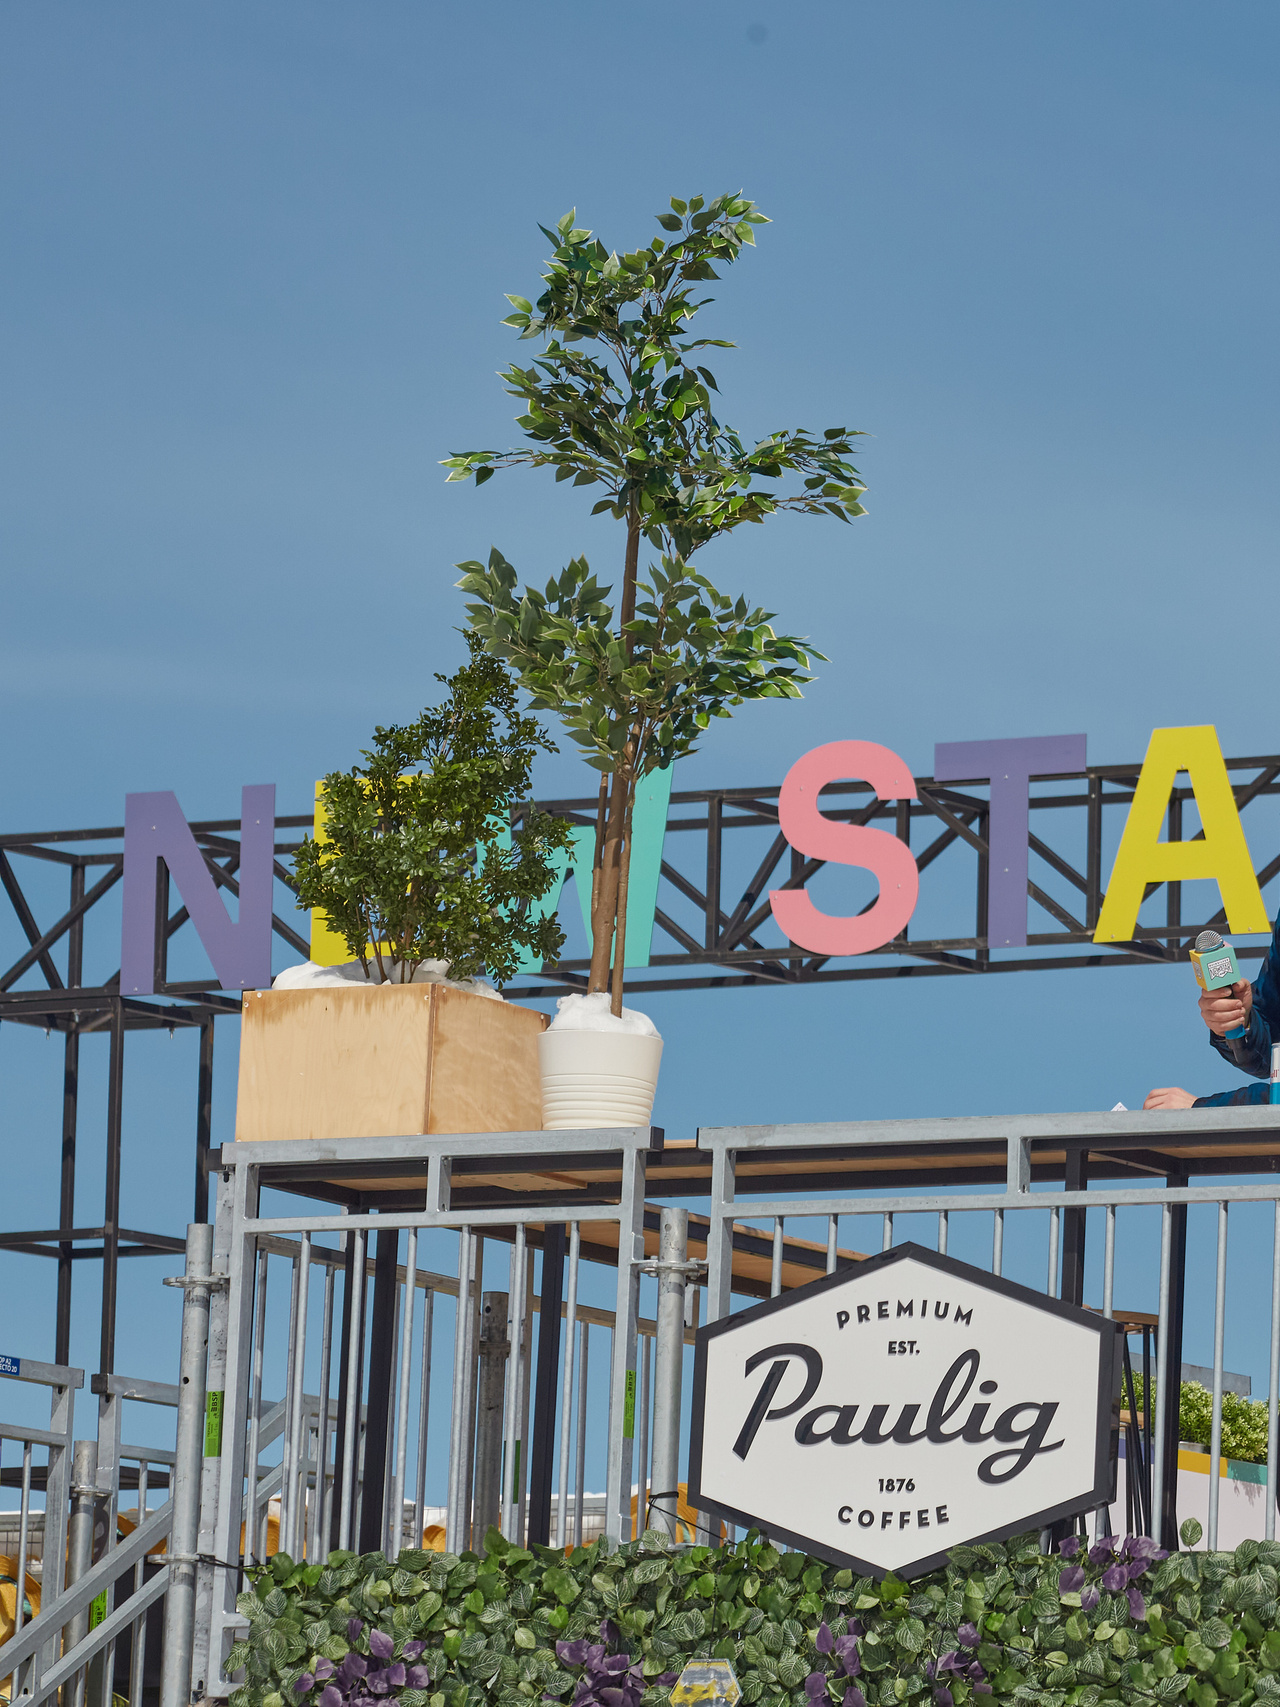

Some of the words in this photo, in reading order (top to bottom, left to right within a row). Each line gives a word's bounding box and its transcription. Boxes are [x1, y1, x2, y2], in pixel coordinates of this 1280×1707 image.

[837, 1299, 974, 1328] PREMIUM
[888, 1340, 920, 1355] EST.
[732, 1342, 1065, 1484] Paulig
[878, 1478, 916, 1493] 1876
[837, 1505, 950, 1530] COFFEE
